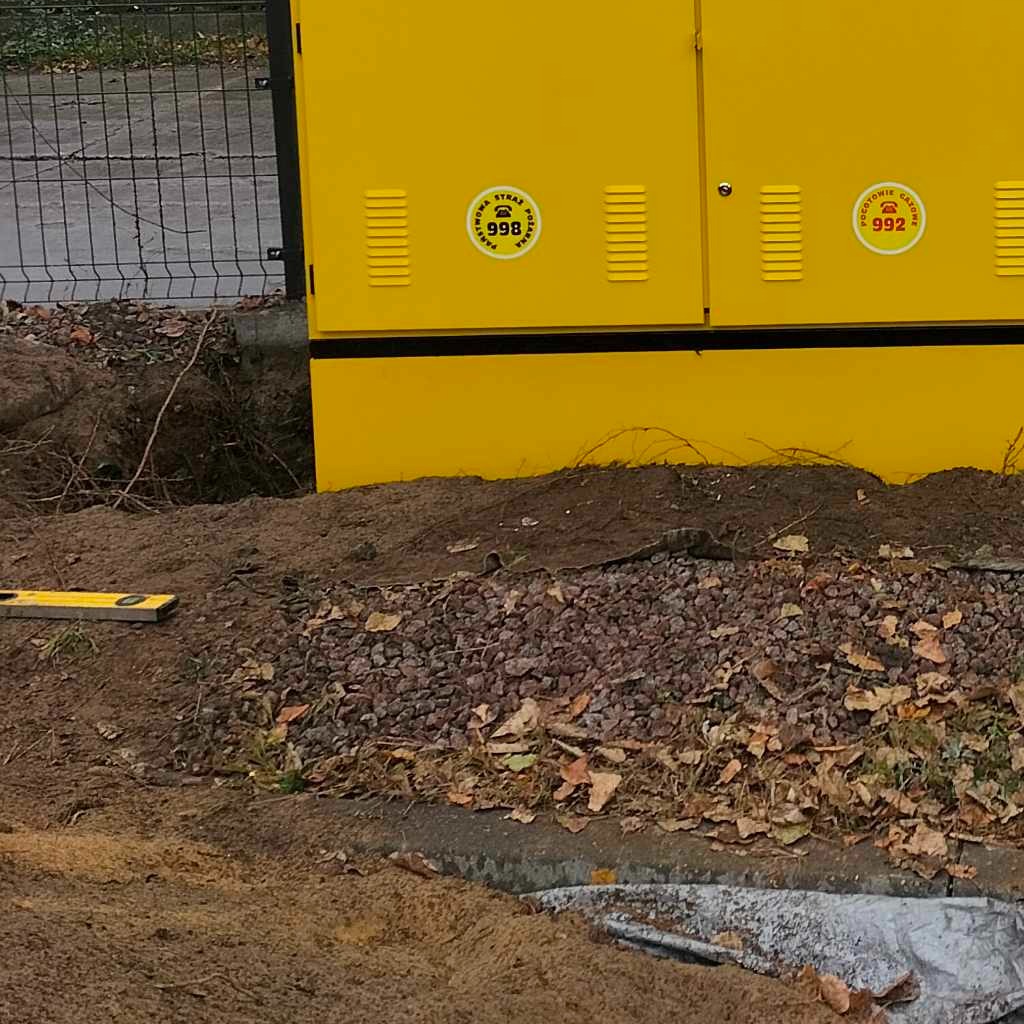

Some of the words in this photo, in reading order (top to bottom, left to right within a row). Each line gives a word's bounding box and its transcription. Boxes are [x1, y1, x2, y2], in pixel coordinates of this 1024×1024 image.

[861, 189, 895, 227] POGOTOWIE
[900, 193, 918, 226] GAZOWE
[487, 221, 522, 237] 998
[872, 217, 906, 232] 992
